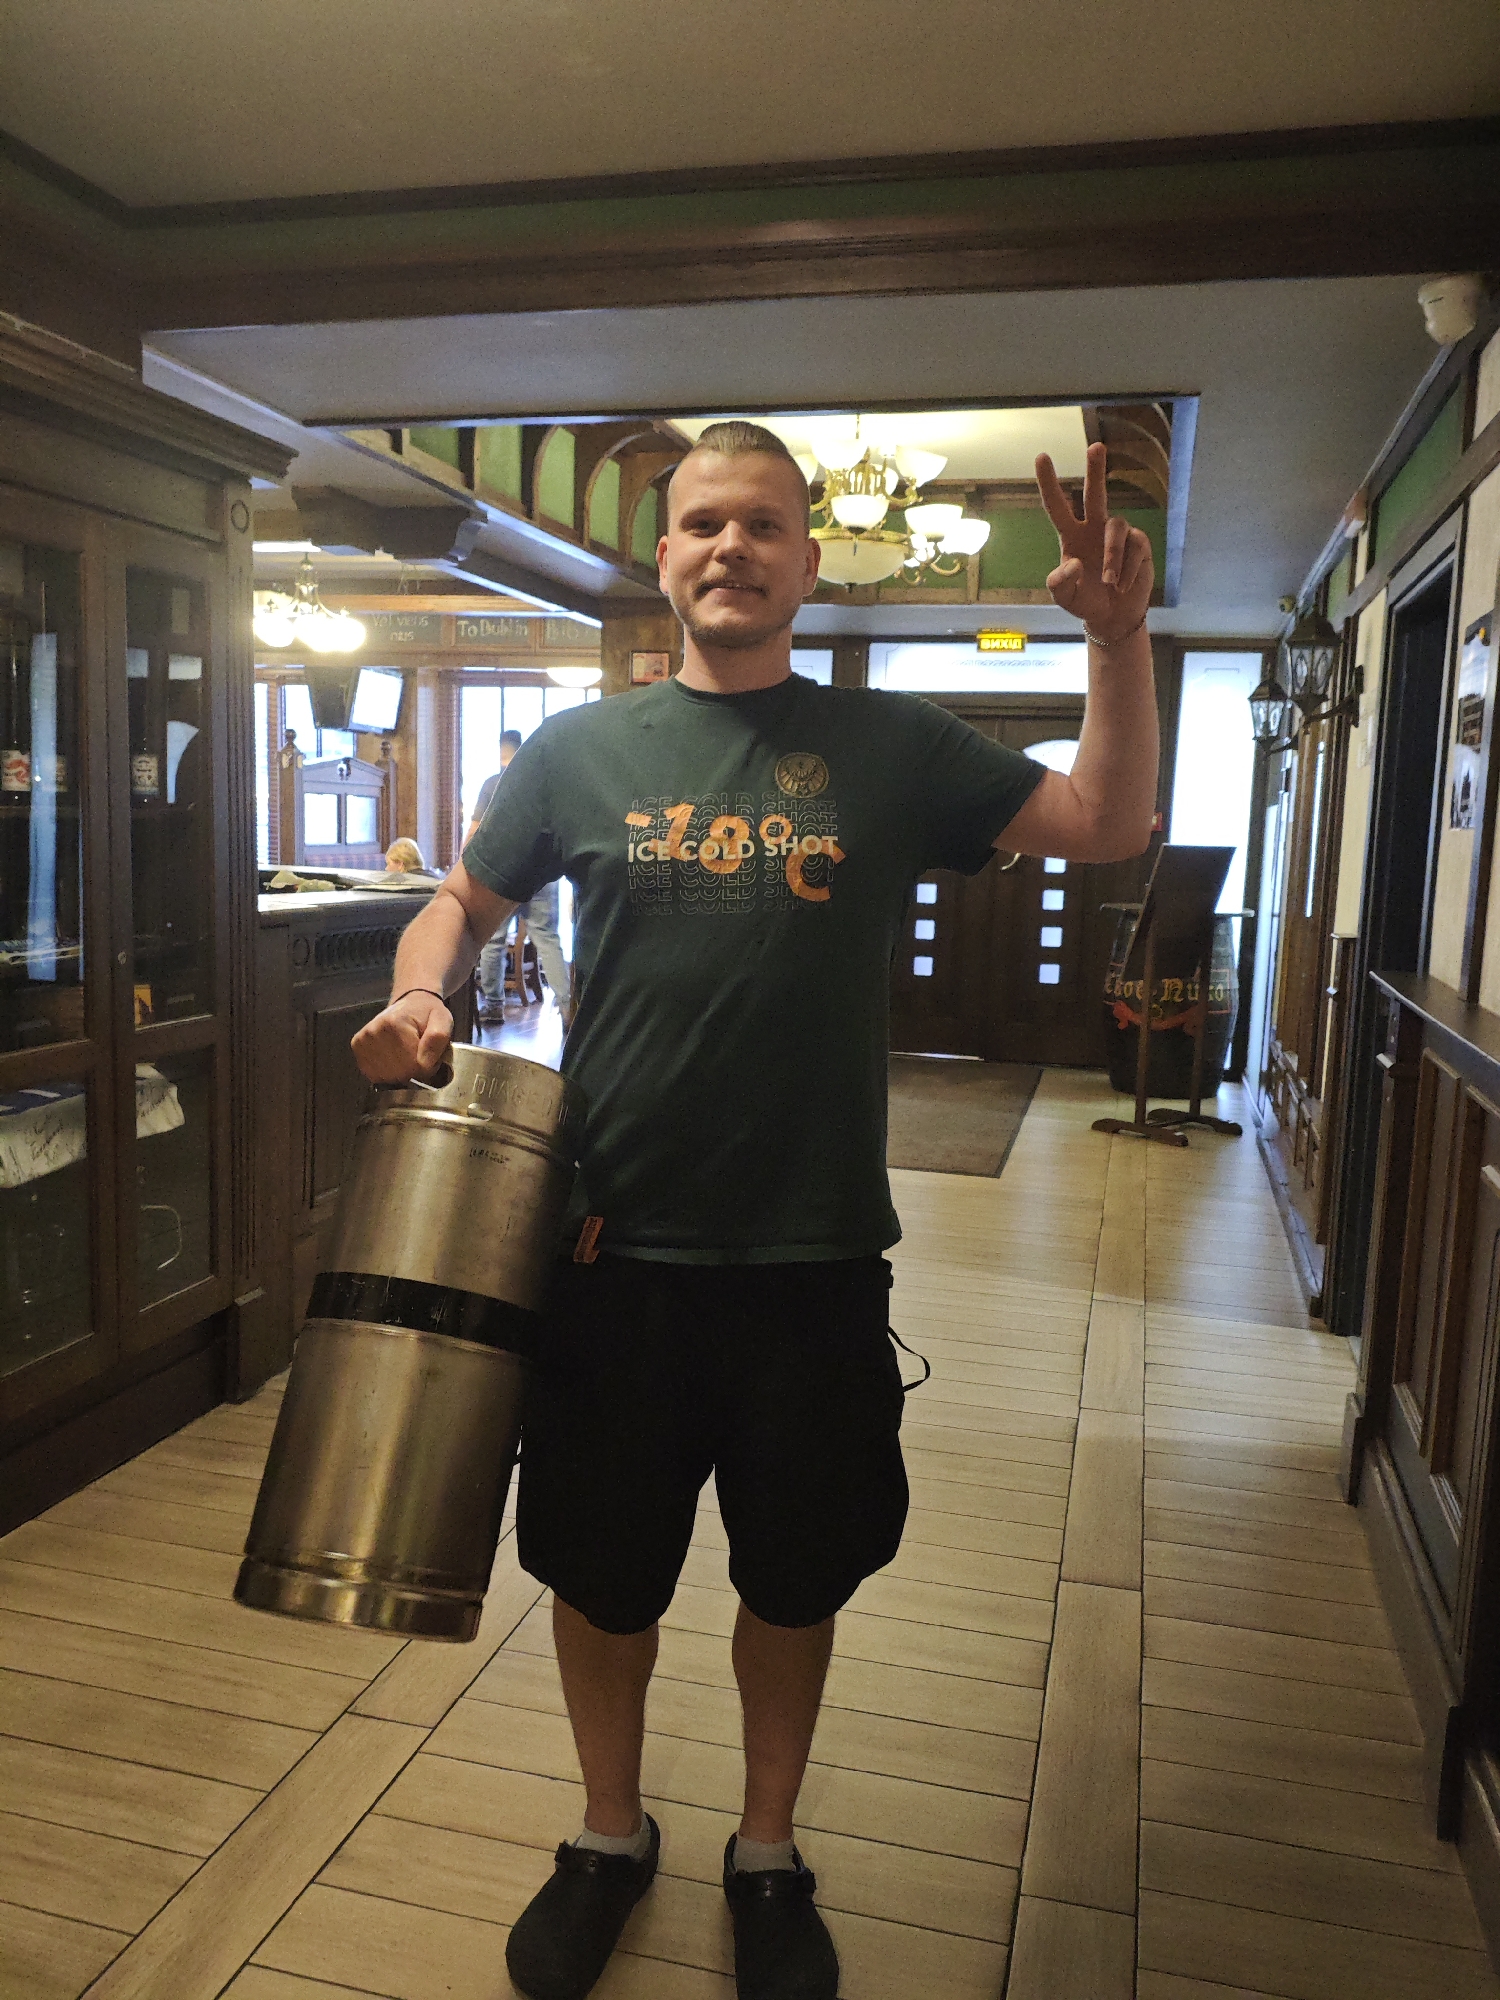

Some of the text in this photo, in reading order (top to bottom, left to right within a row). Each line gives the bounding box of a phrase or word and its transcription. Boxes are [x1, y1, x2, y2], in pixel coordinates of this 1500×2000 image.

[628, 840, 672, 863] ICE
[680, 839, 755, 861] COLD
[765, 834, 839, 858] SHOT
